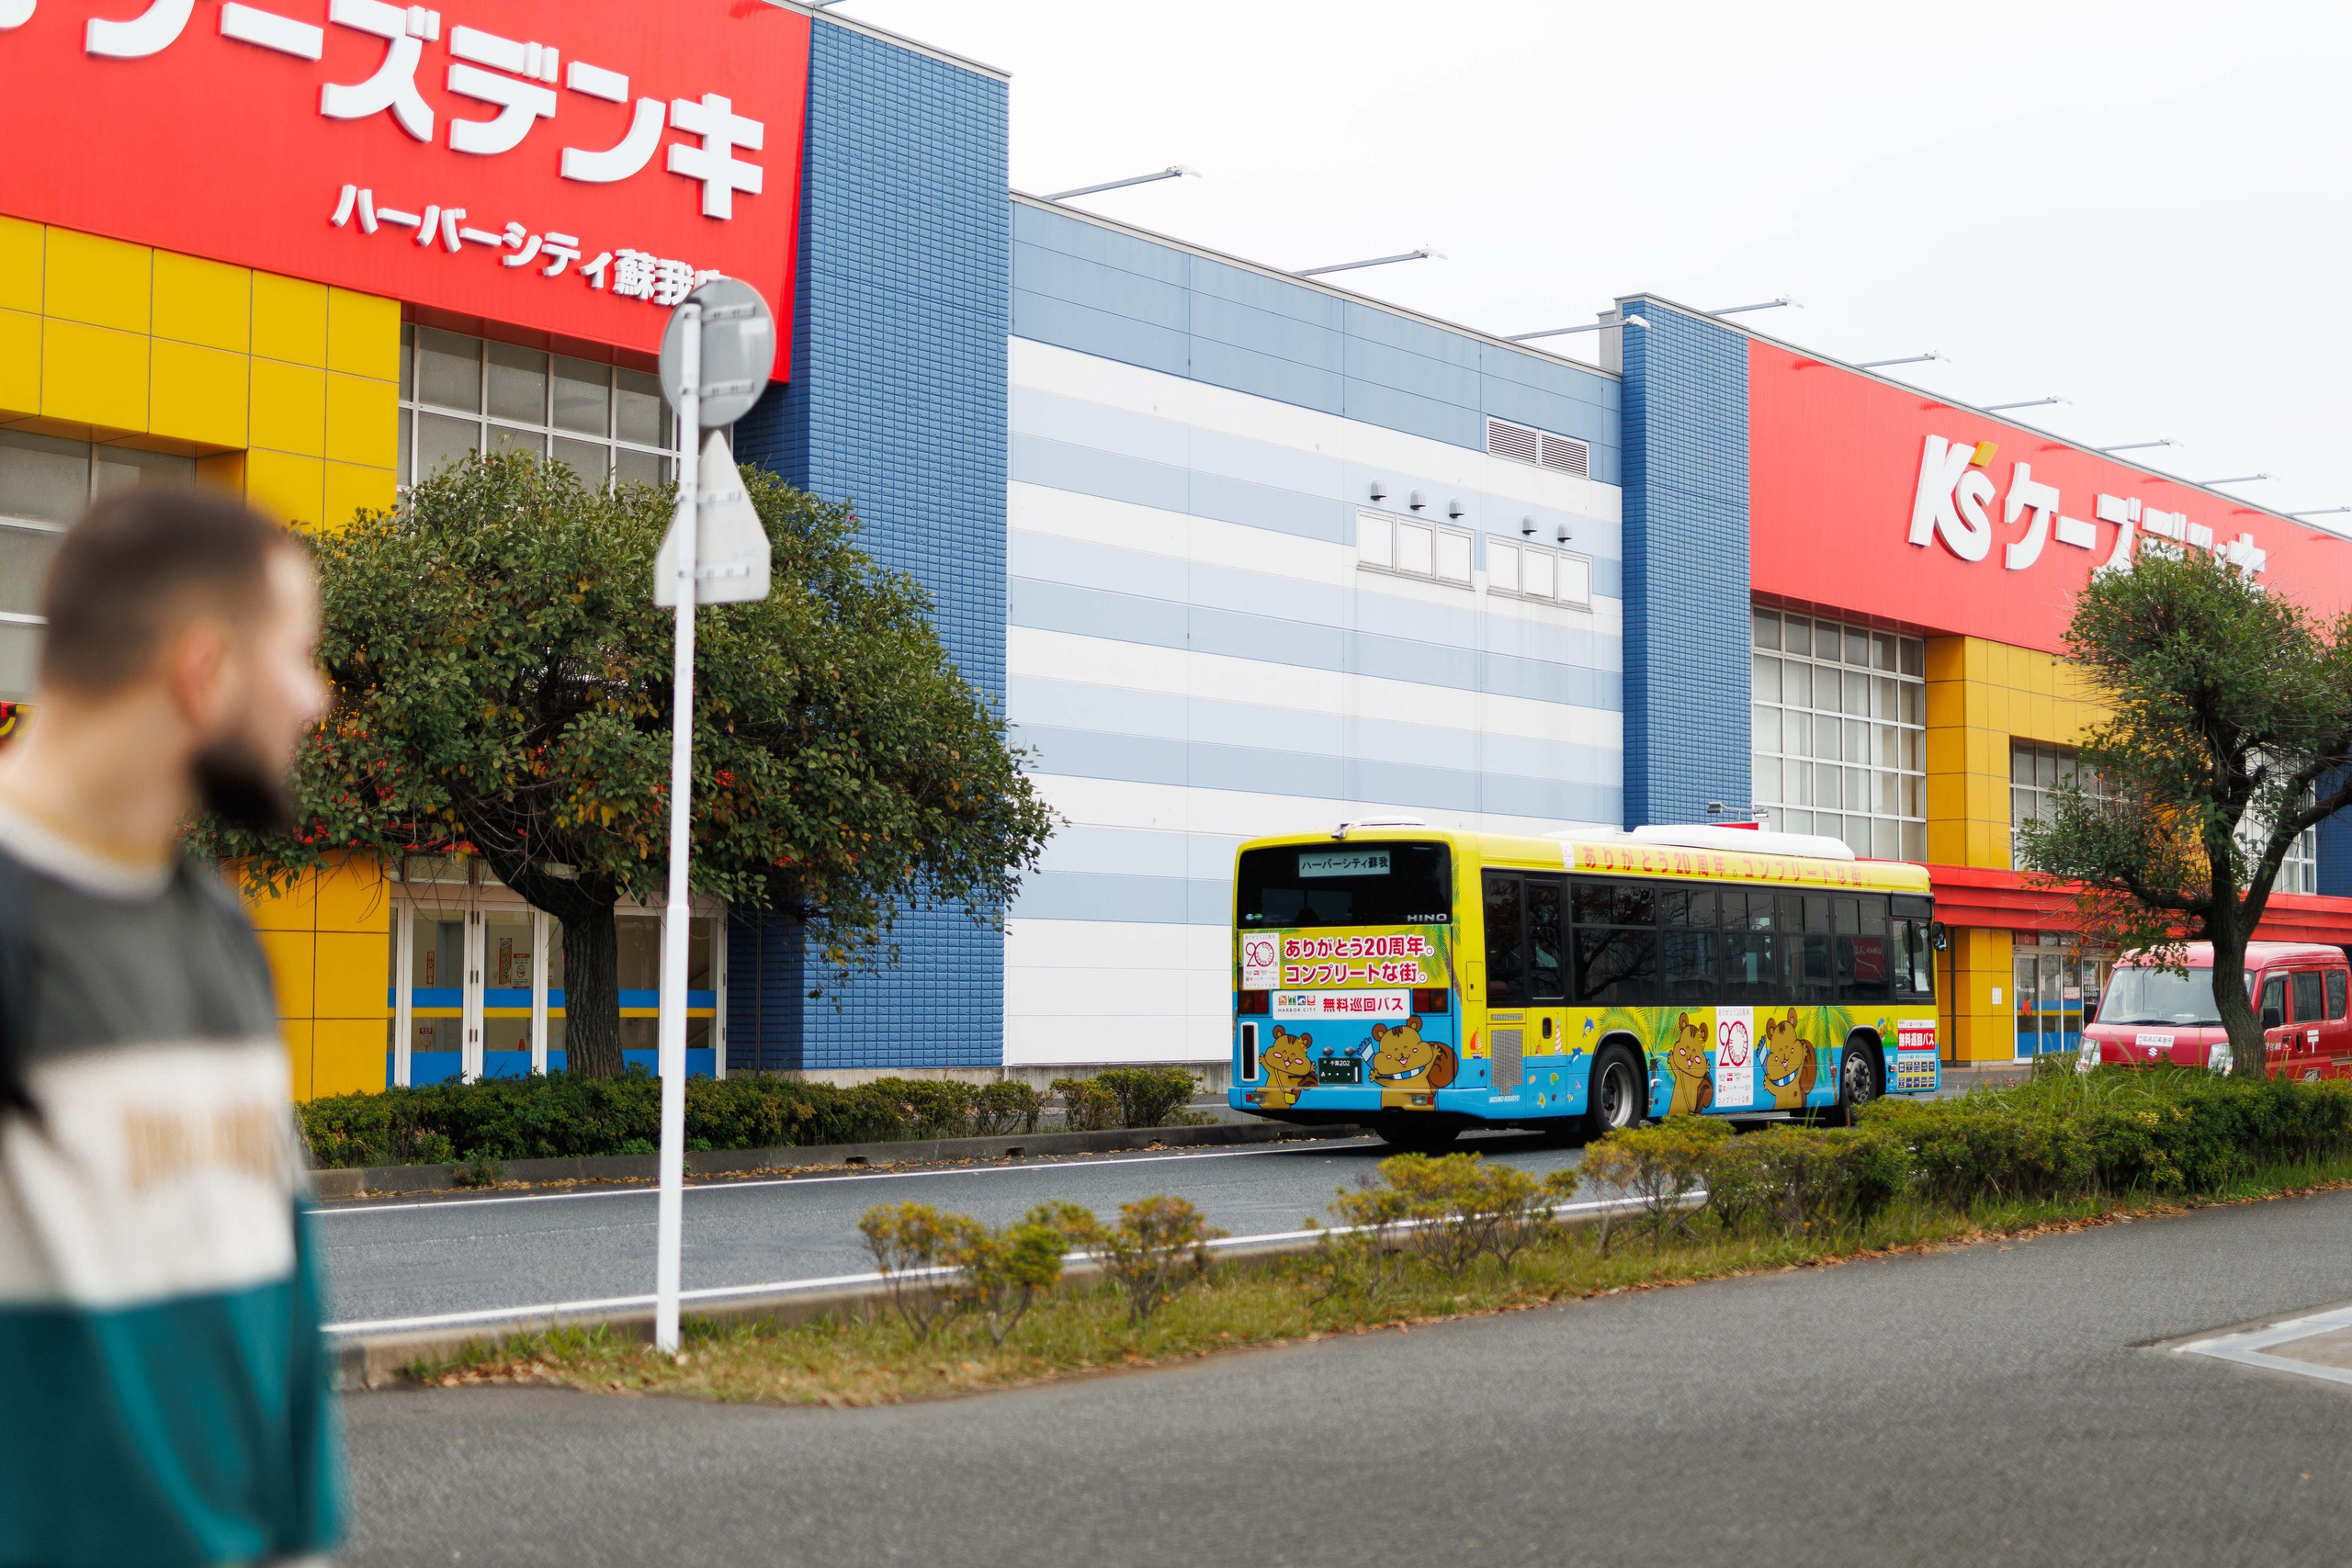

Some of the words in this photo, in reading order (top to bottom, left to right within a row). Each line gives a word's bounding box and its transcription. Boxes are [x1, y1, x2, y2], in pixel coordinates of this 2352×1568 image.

[1908, 434, 1998, 562] K's
[1302, 856, 1389, 870] ハーバーシティ蘇我
[1407, 913, 1447, 922] HINO
[1285, 936, 1434, 958] ありがとう20周年。
[1286, 963, 1426, 983] コンプリートな街。
[1323, 997, 1404, 1012] 無料巡回バス
[1898, 1032, 1935, 1047] 無料巡回バス
